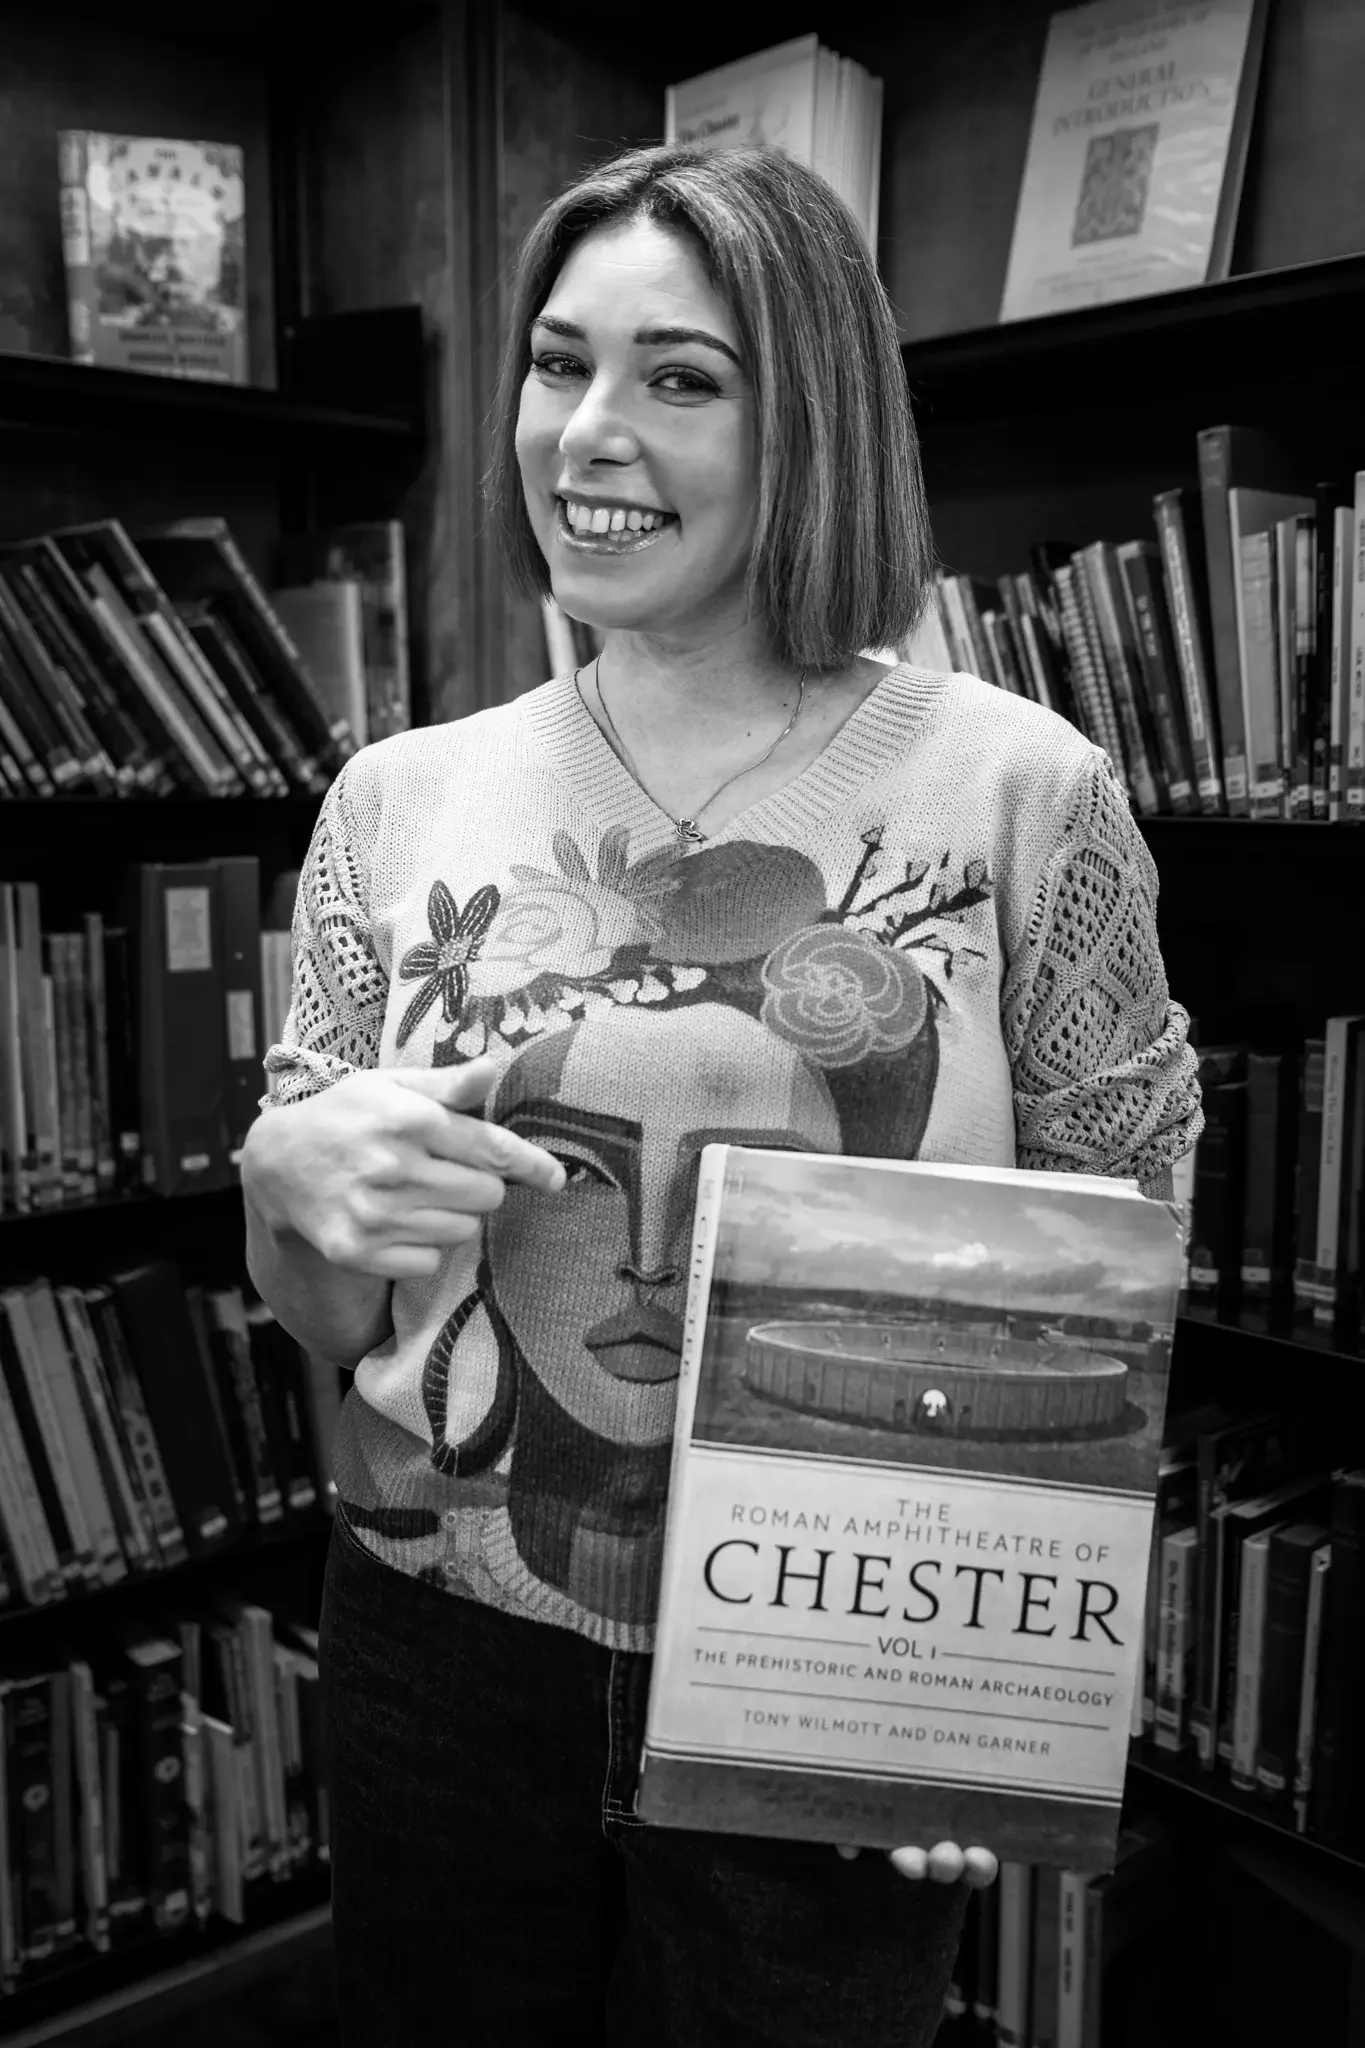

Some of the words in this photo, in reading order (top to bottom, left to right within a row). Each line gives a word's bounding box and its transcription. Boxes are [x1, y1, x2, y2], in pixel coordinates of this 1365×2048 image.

[731, 1504, 831, 1533] ROMAN
[843, 1517, 1062, 1559] AMPHITHEATRE
[1075, 1543, 1110, 1563] OF
[897, 1499, 951, 1523] THE
[703, 1539, 1125, 1647] CHESTER
[878, 1636, 923, 1660] VOL
[695, 1649, 727, 1665] THE
[736, 1652, 858, 1678] PREHISTORIC
[864, 1666, 902, 1683] AND
[909, 1671, 973, 1691] ROMAN
[980, 1679, 1114, 1707] ARCHAEOLOGY
[744, 1709, 790, 1727] TONY
[799, 1715, 882, 1736] WILMOTT
[889, 1725, 926, 1741] AND
[933, 1729, 971, 1746] DAN
[977, 1734, 1051, 1756] GARNER
